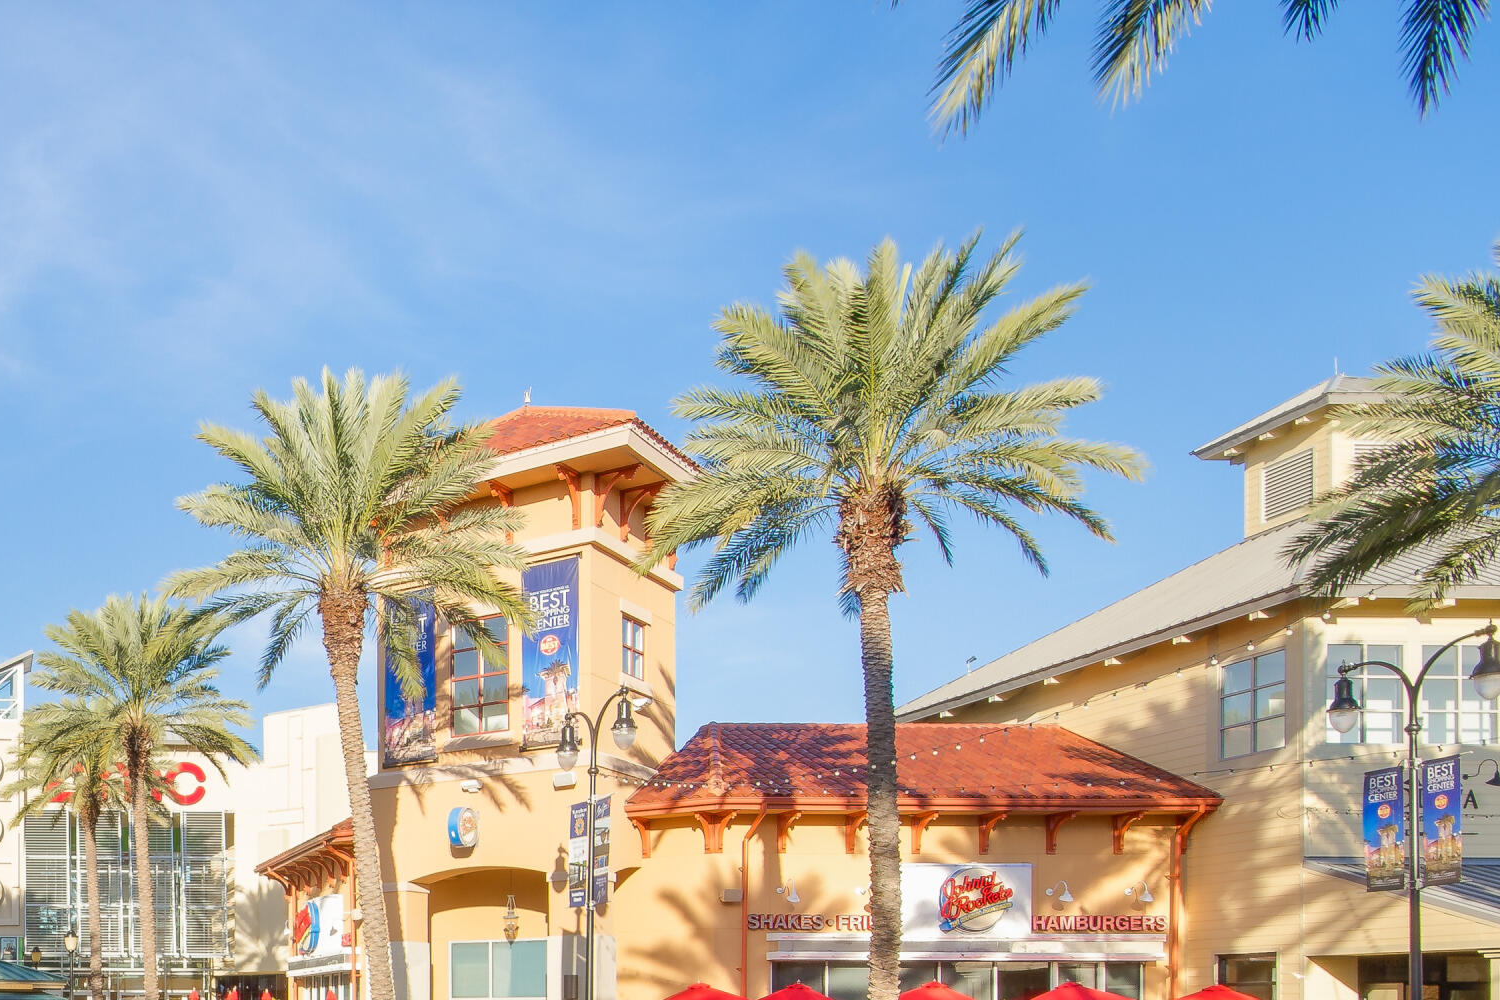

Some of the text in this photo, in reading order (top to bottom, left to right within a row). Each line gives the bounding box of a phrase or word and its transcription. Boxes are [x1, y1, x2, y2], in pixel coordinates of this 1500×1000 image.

[530, 589, 570, 611] BEST
[539, 606, 570, 618] OPPING
[1427, 762, 1455, 779] BEST
[1369, 773, 1398, 789] BEST
[1427, 780, 1455, 792] CENTER
[1368, 790, 1398, 802] CENTER
[942, 871, 1003, 899] Johnny
[941, 885, 1013, 919] Rockets
[747, 914, 873, 931] SHAKES FRI
[1032, 915, 1168, 931] HAMBURGERS
